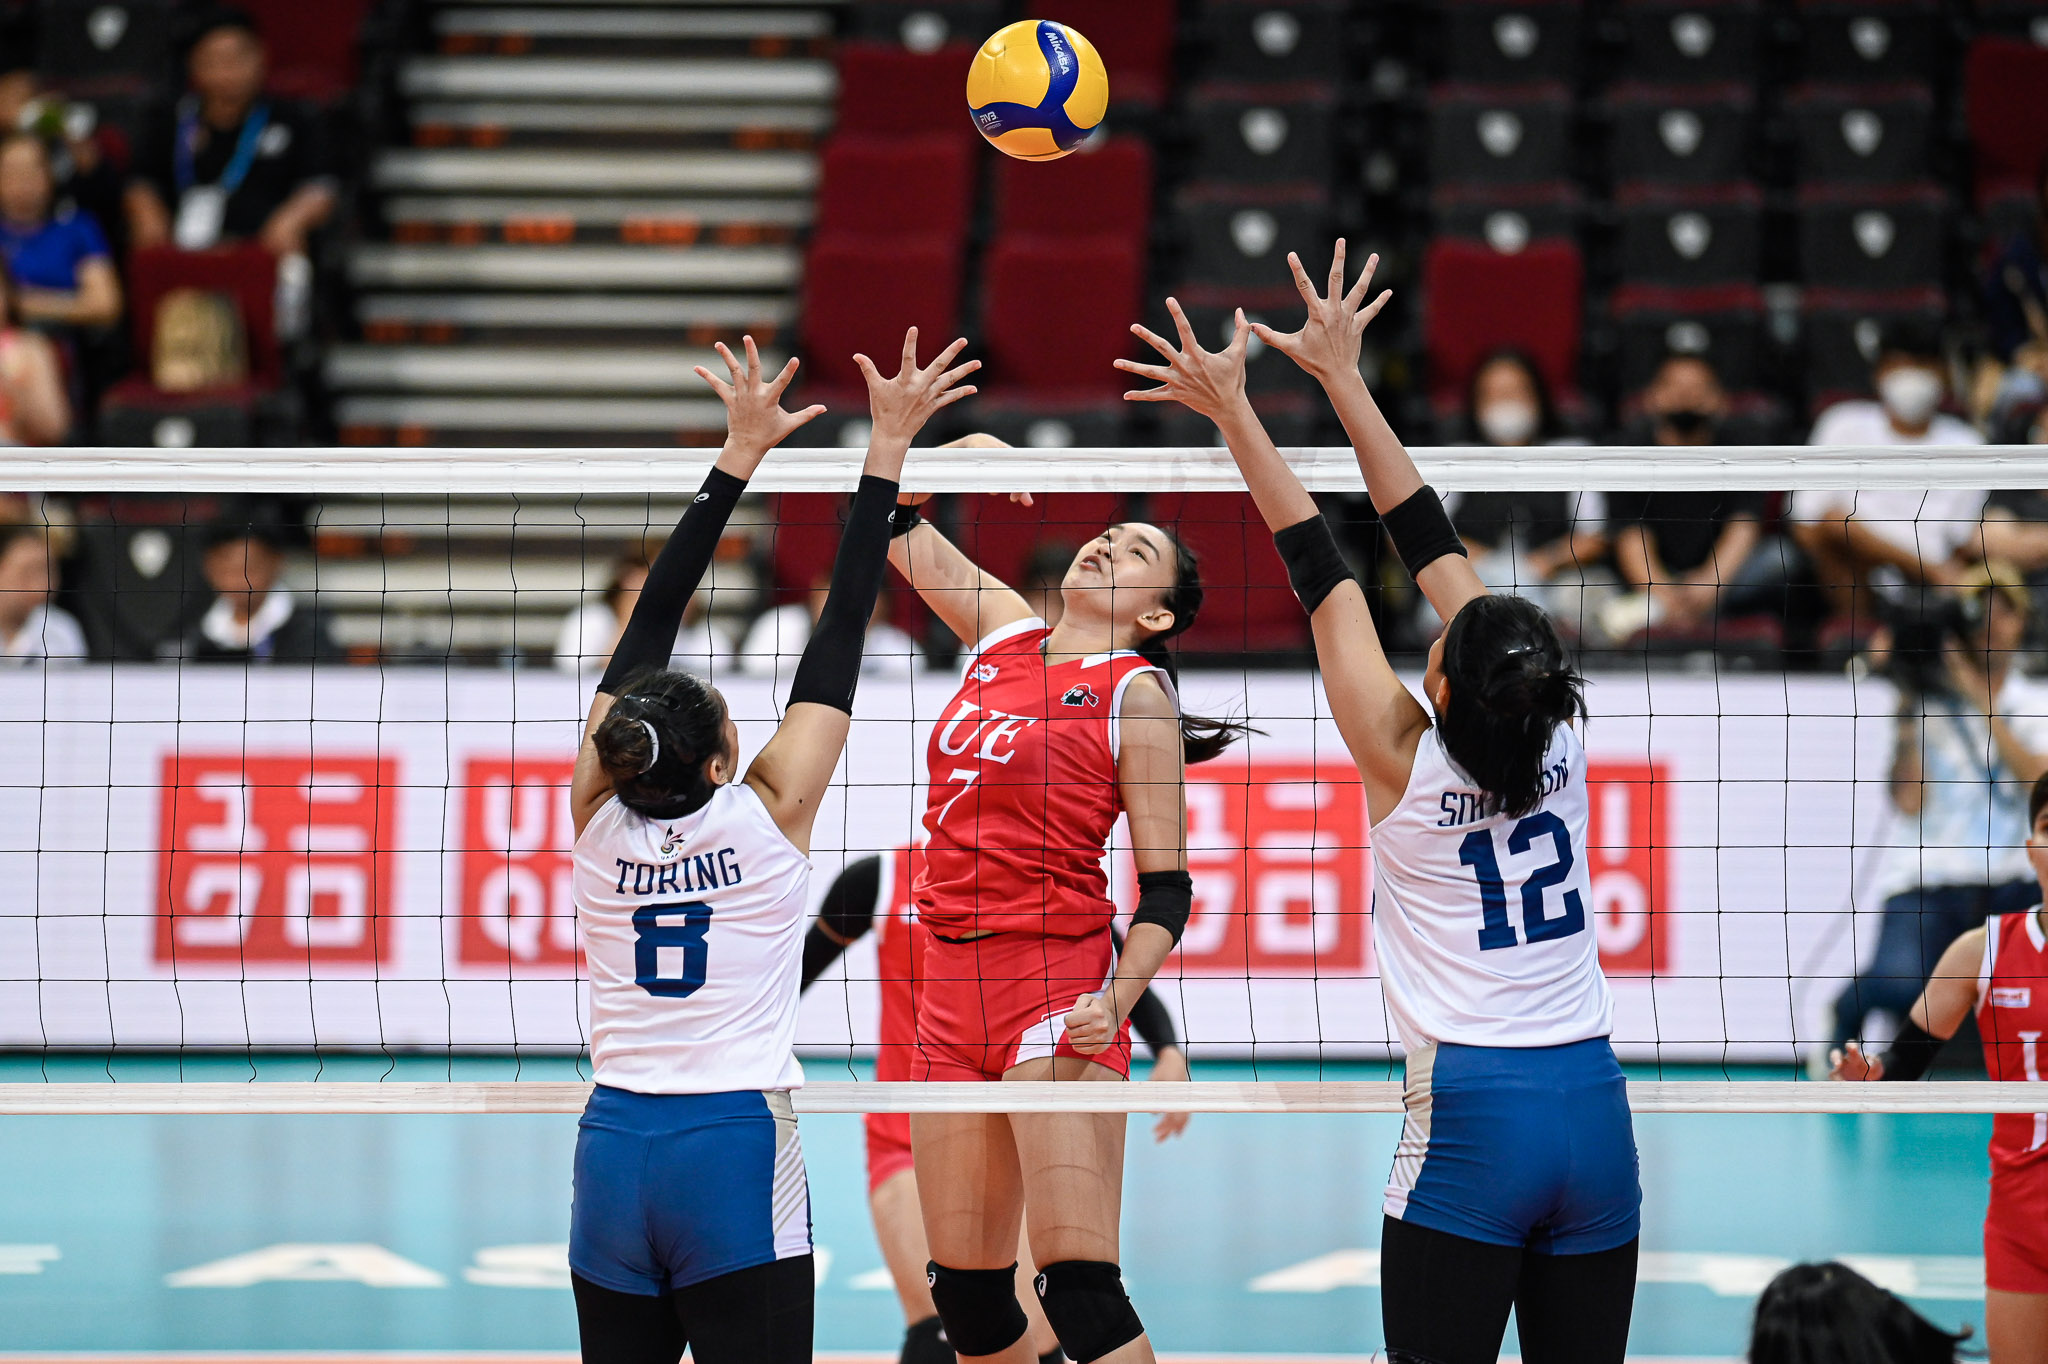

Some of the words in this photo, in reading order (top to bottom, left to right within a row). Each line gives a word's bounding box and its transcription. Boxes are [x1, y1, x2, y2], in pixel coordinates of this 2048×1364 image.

[979, 111, 997, 124] FIVB
[938, 699, 1039, 765] UE
[937, 768, 980, 826] 7
[616, 847, 742, 895] TORING
[1458, 810, 1585, 951] 12
[632, 900, 713, 998] 8
